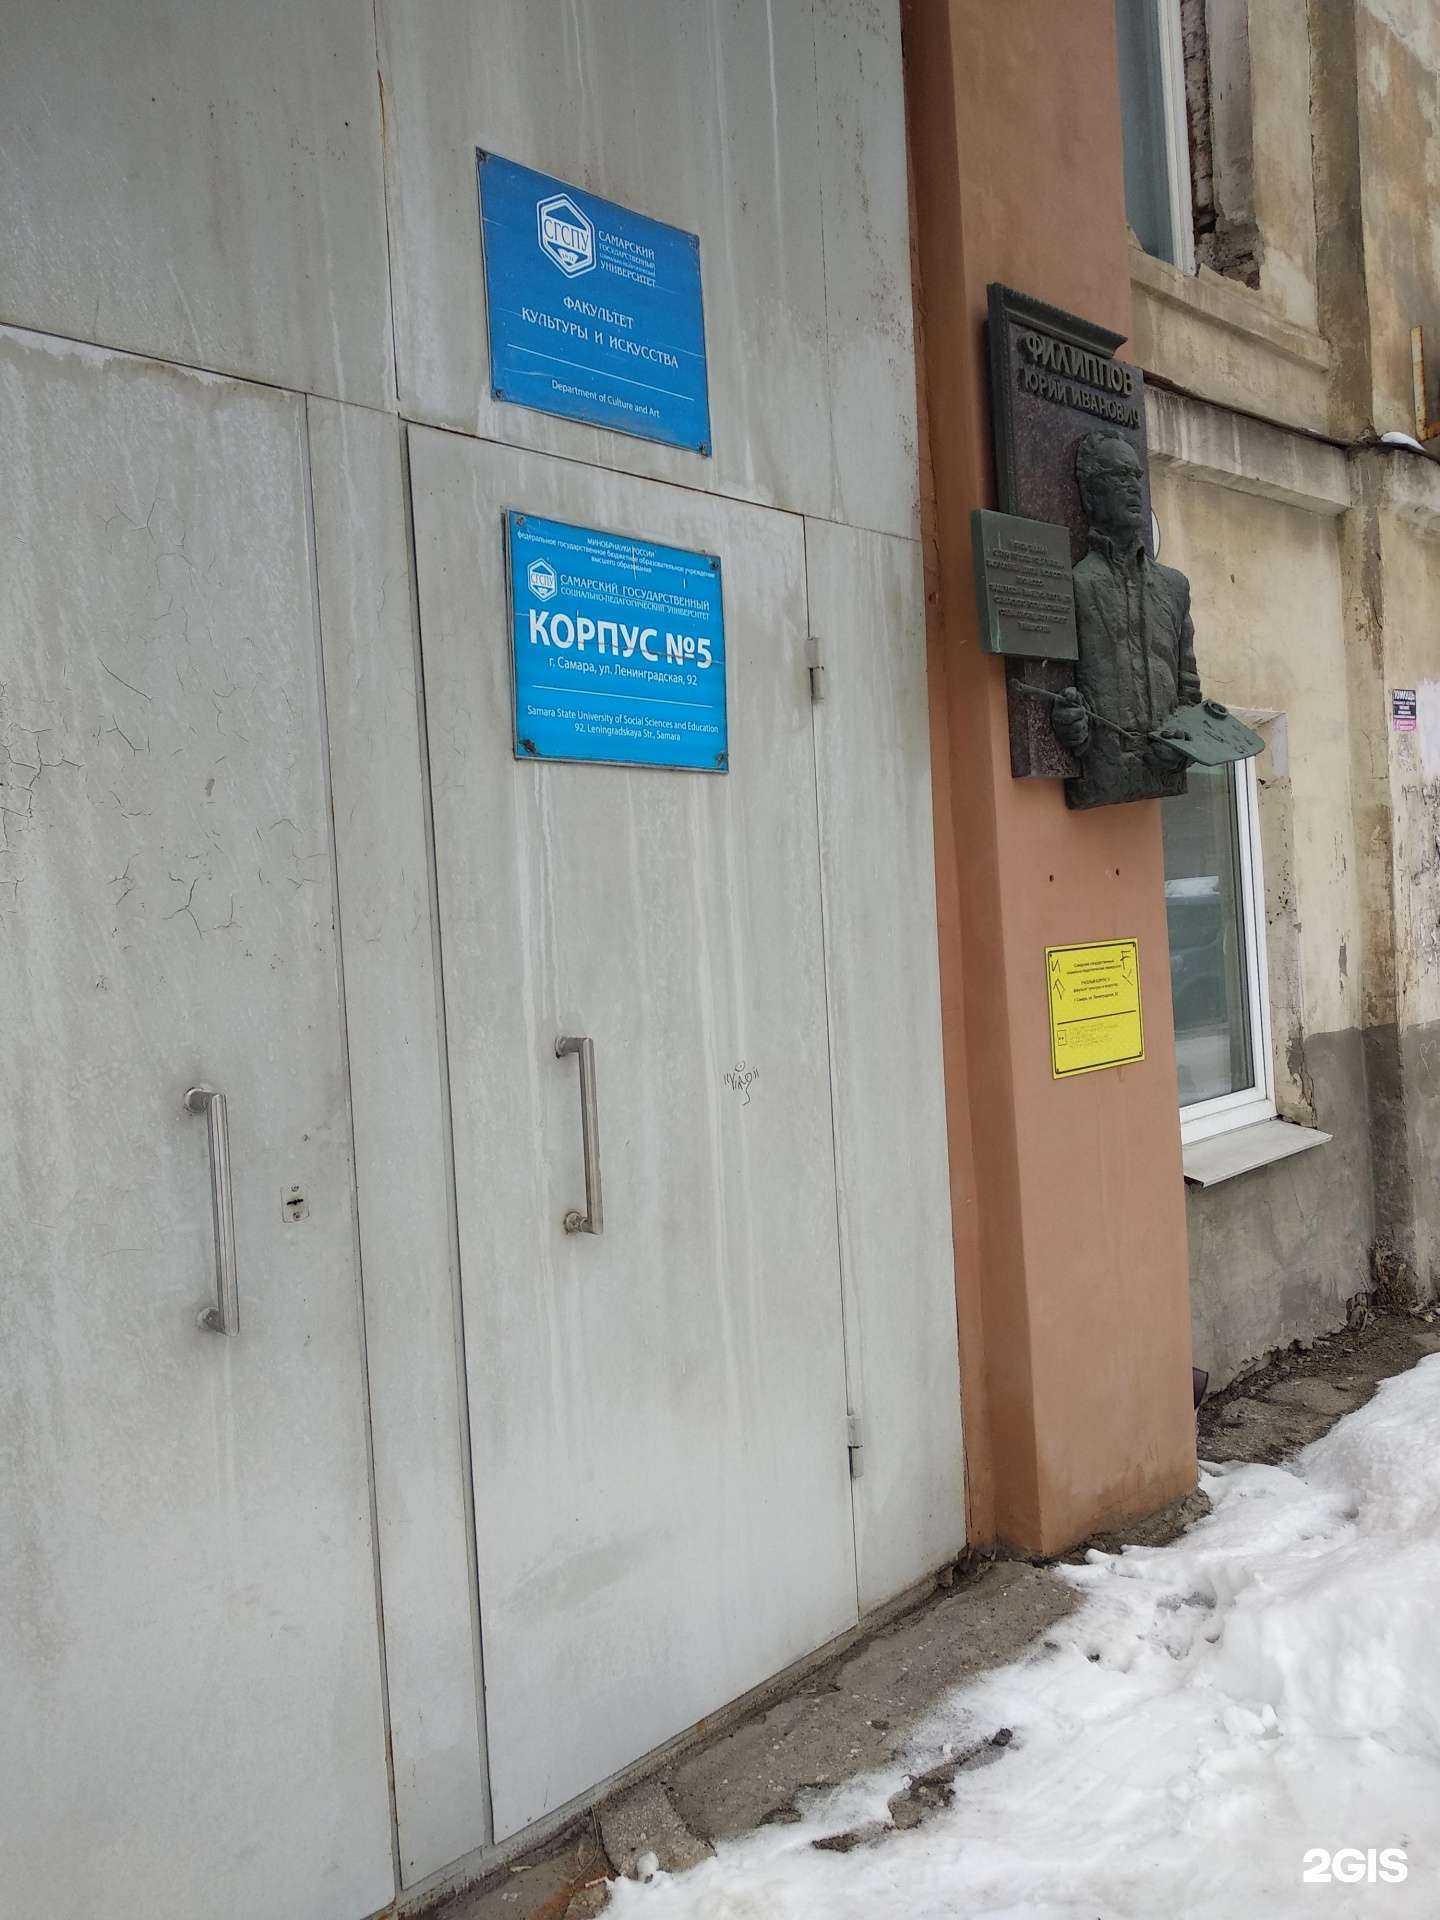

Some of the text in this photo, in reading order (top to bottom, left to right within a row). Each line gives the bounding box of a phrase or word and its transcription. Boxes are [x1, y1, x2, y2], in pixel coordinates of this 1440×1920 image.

[544, 218, 589, 252] СГСПУ
[598, 230, 656, 260] САМАРСКИЙ
[600, 260, 656, 288] УНИВЕРСИТЕТ
[563, 295, 634, 330] ФАКУЛЬТЕТ
[521, 307, 679, 368] КУЛЬТУРЫ И ИСКУССТВА
[1026, 334, 1135, 397] ФИЛИППОВ
[552, 379, 660, 417] Department of Culture and Art
[1024, 366, 1140, 428] ЮРИЙ ИВАНОВИЧ
[560, 574, 710, 611] САМАРСКИЙ ГОСУДАРСТВЕННЫЙ
[529, 608, 712, 669] КОРПУС №5
[557, 656, 597, 675] Самара,
[599, 664, 612, 675] ул.
[614, 664, 685, 684] Ленинградская,
[686, 674, 698, 686] 92
[528, 705, 719, 733] Samara State University of Social Sciences and Education
[587, 724, 642, 738] Leningradskaya
[657, 729, 680, 741] Samara
